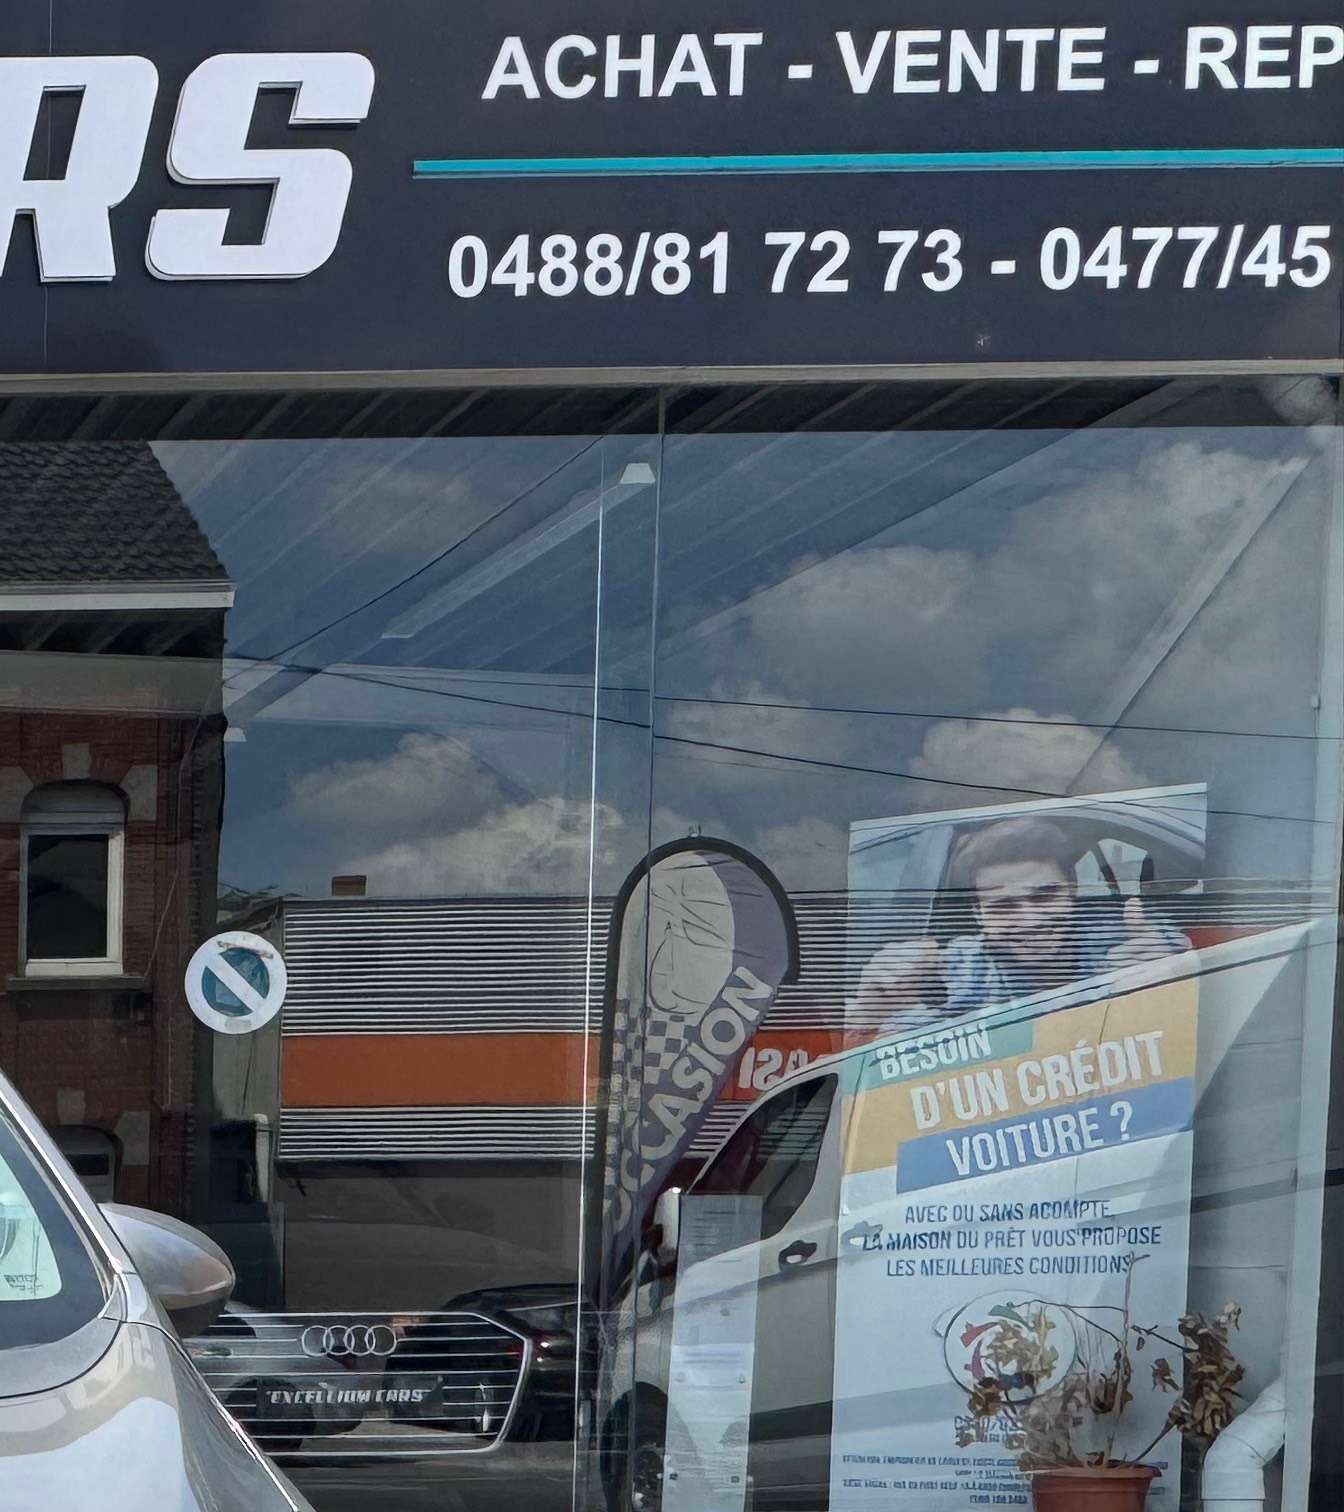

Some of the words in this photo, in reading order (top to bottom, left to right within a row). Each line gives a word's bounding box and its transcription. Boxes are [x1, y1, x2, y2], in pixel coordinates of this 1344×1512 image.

[481, 32, 763, 101] ACHAT
[787, 63, 813, 80] -
[835, 26, 1108, 95] VENTE
[1184, 24, 1344, 91] REP
[447, 230, 729, 299] 0488/81
[764, 229, 852, 294] 72
[877, 228, 964, 293] 73
[990, 258, 1017, 276] -
[1039, 223, 1332, 291] 0477/45
[876, 1023, 992, 1081] BESOIN
[910, 1068, 1009, 1130] D'UN
[1016, 1031, 1164, 1106] CRÉDIT
[946, 1107, 1104, 1176] VOITURE
[1110, 1100, 1134, 1141] ?
[862, 1232, 883, 1251] LA
[887, 1230, 952, 1250] MAISON
[957, 1230, 979, 1249] DU
[1032, 1228, 1075, 1248] VOUS
[1081, 1226, 1162, 1246] PROPOSE
[905, 1204, 947, 1224] AVEC
[952, 1203, 975, 1223] OU
[979, 1201, 1024, 1222] SANS
[887, 1259, 916, 1277] LES
[920, 1256, 1024, 1277] MEILLEURES
